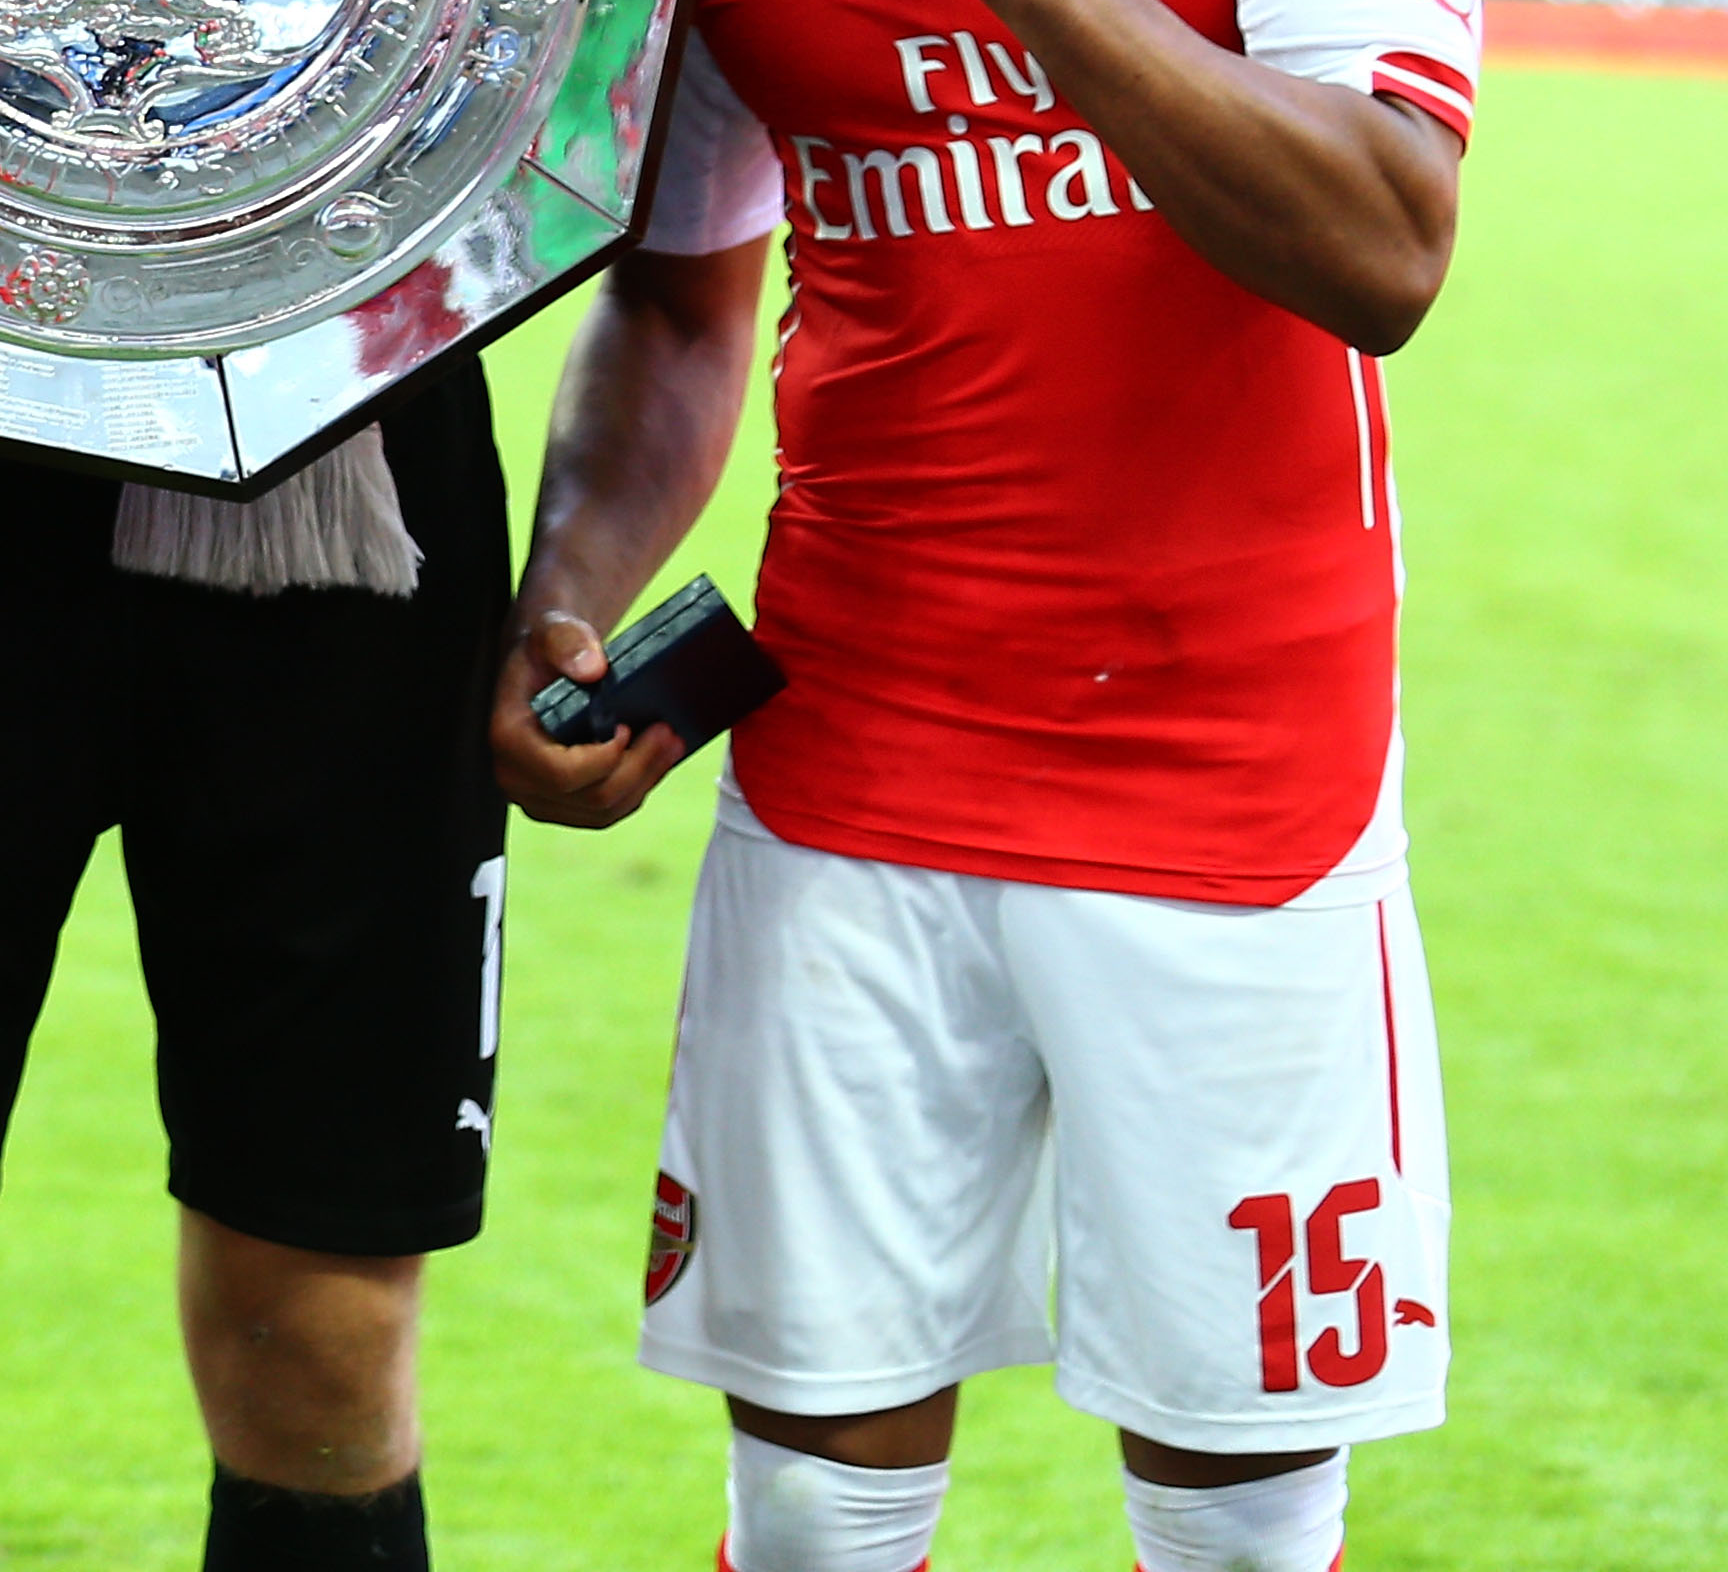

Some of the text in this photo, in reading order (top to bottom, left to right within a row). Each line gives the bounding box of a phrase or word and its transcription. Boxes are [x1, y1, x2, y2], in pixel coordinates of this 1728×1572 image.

[893, 30, 1056, 114] Fly
[470, 854, 505, 1060] 1
[1228, 1176, 1387, 1393] 15
